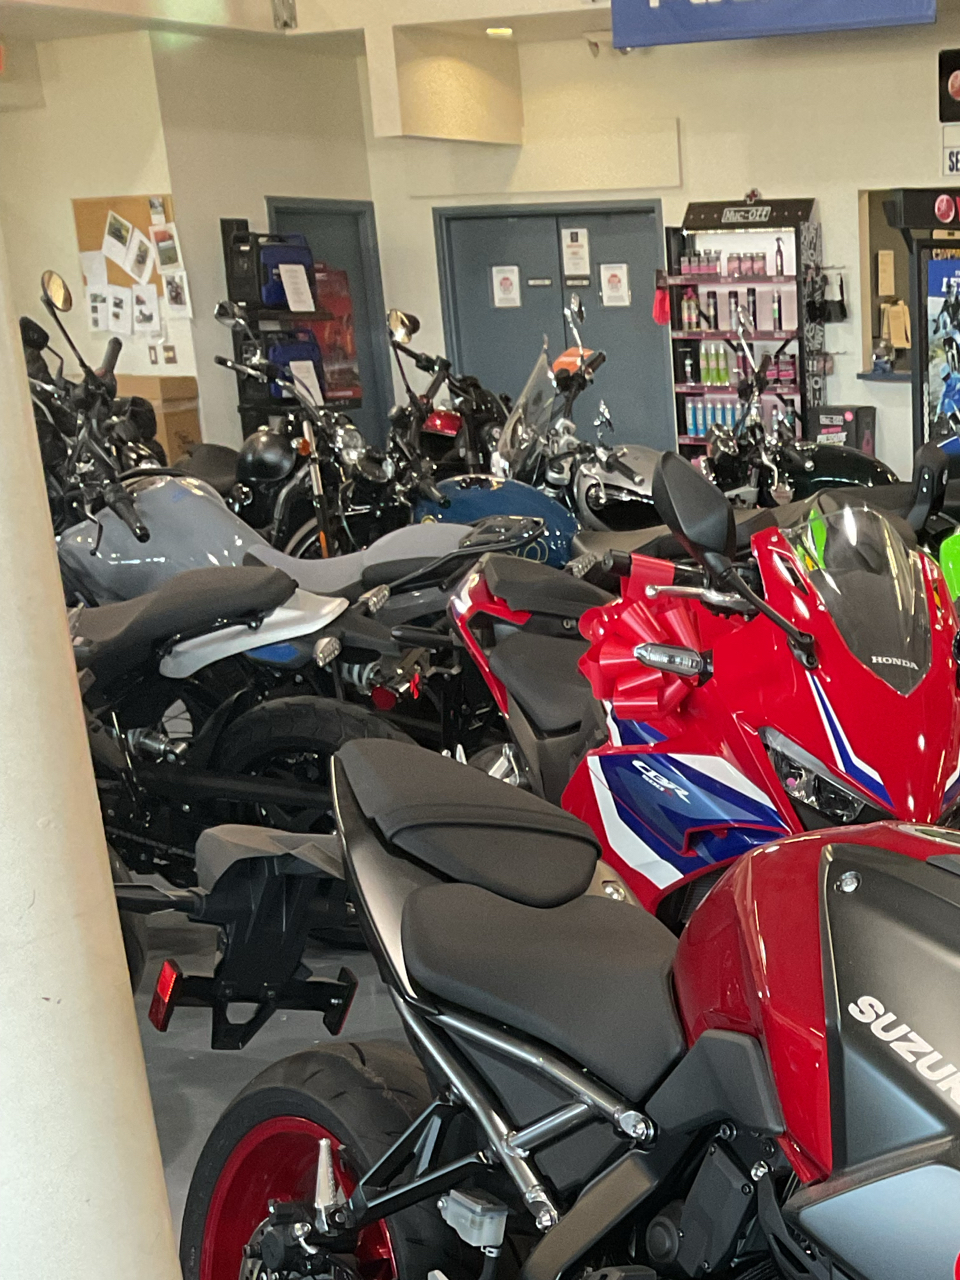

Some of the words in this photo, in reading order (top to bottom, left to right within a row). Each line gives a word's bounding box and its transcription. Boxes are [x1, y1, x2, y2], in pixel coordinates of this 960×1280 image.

[725, 208, 769, 222] Muc-Off
[871, 655, 920, 670] HONDA
[631, 759, 692, 804] CBR
